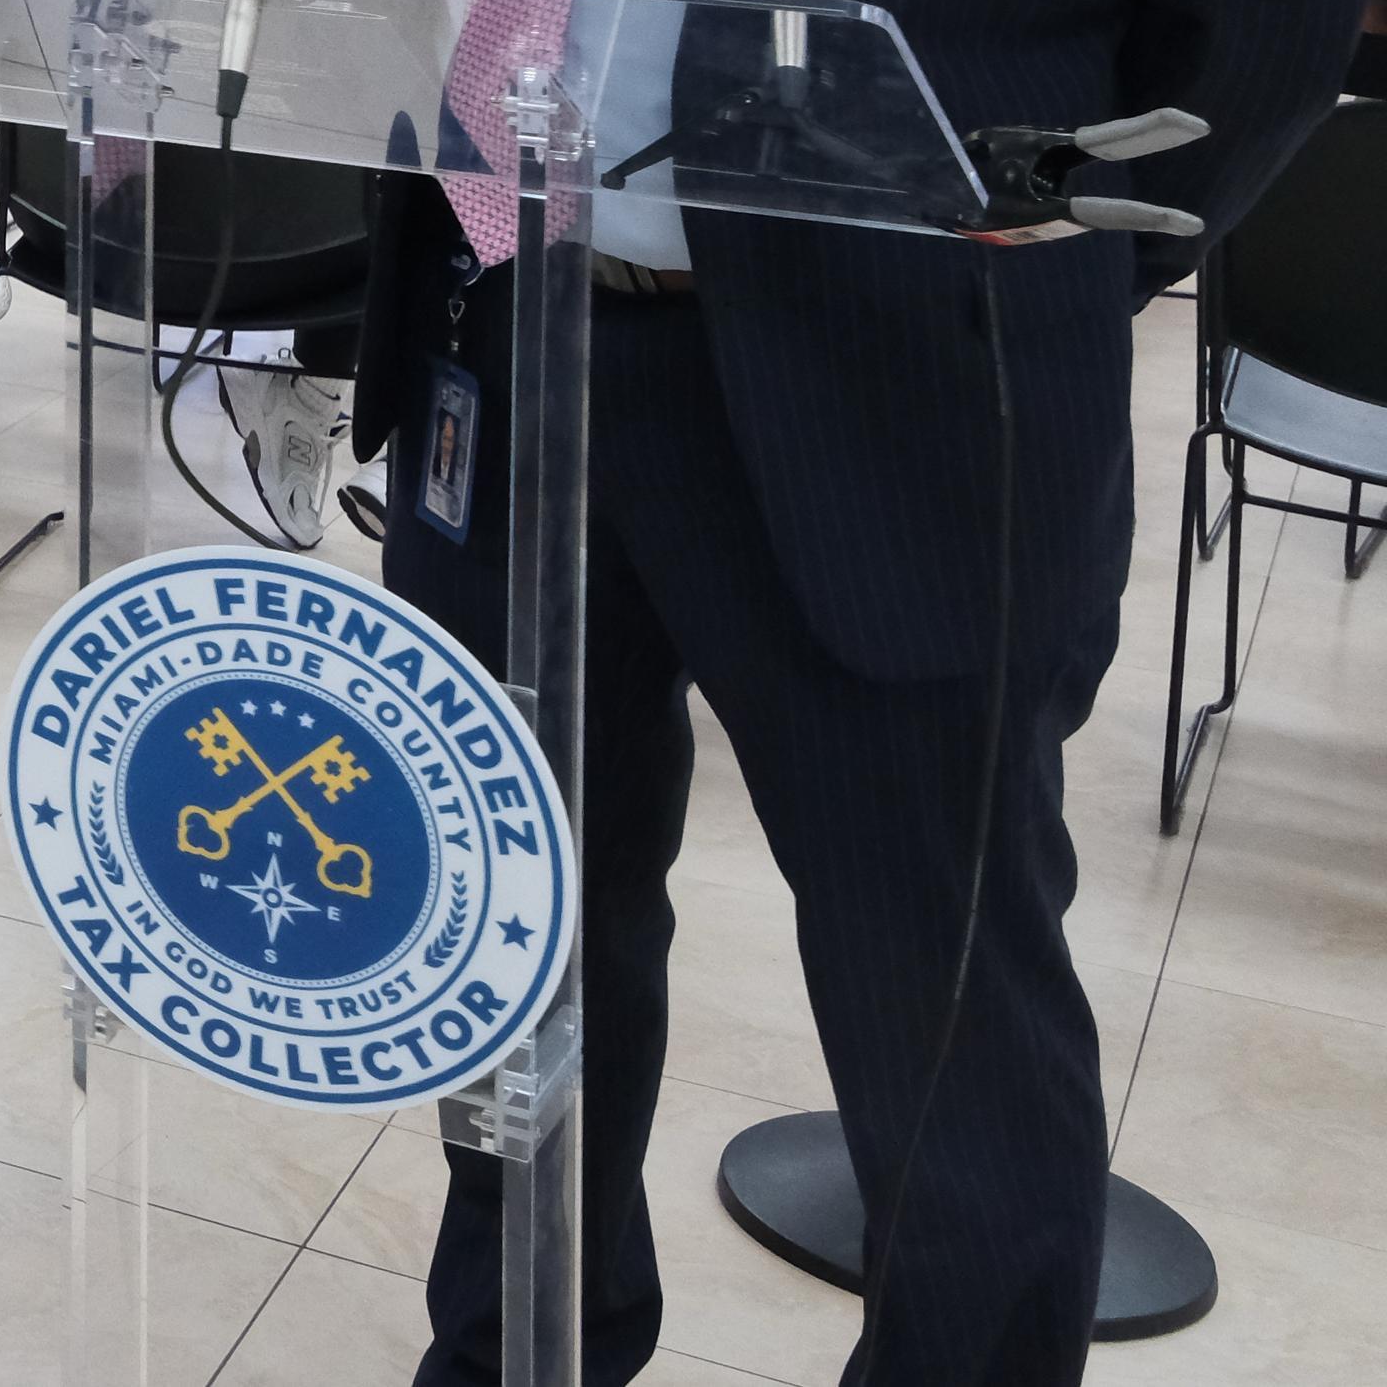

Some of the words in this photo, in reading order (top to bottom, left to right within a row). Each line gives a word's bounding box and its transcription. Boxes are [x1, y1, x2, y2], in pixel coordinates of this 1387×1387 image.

[31, 586, 195, 749] DARIEL
[213, 577, 540, 858] FERNANDEZ
[89, 637, 325, 766] MIAMI-DADE
[348, 676, 472, 854] COUNTY
[57, 875, 152, 995] TAX
[160, 979, 510, 1086] COLLECTOR
[125, 900, 161, 935] IN
[164, 940, 233, 997] GOD
[248, 988, 304, 1020] WE
[316, 972, 419, 1021] TRUST
